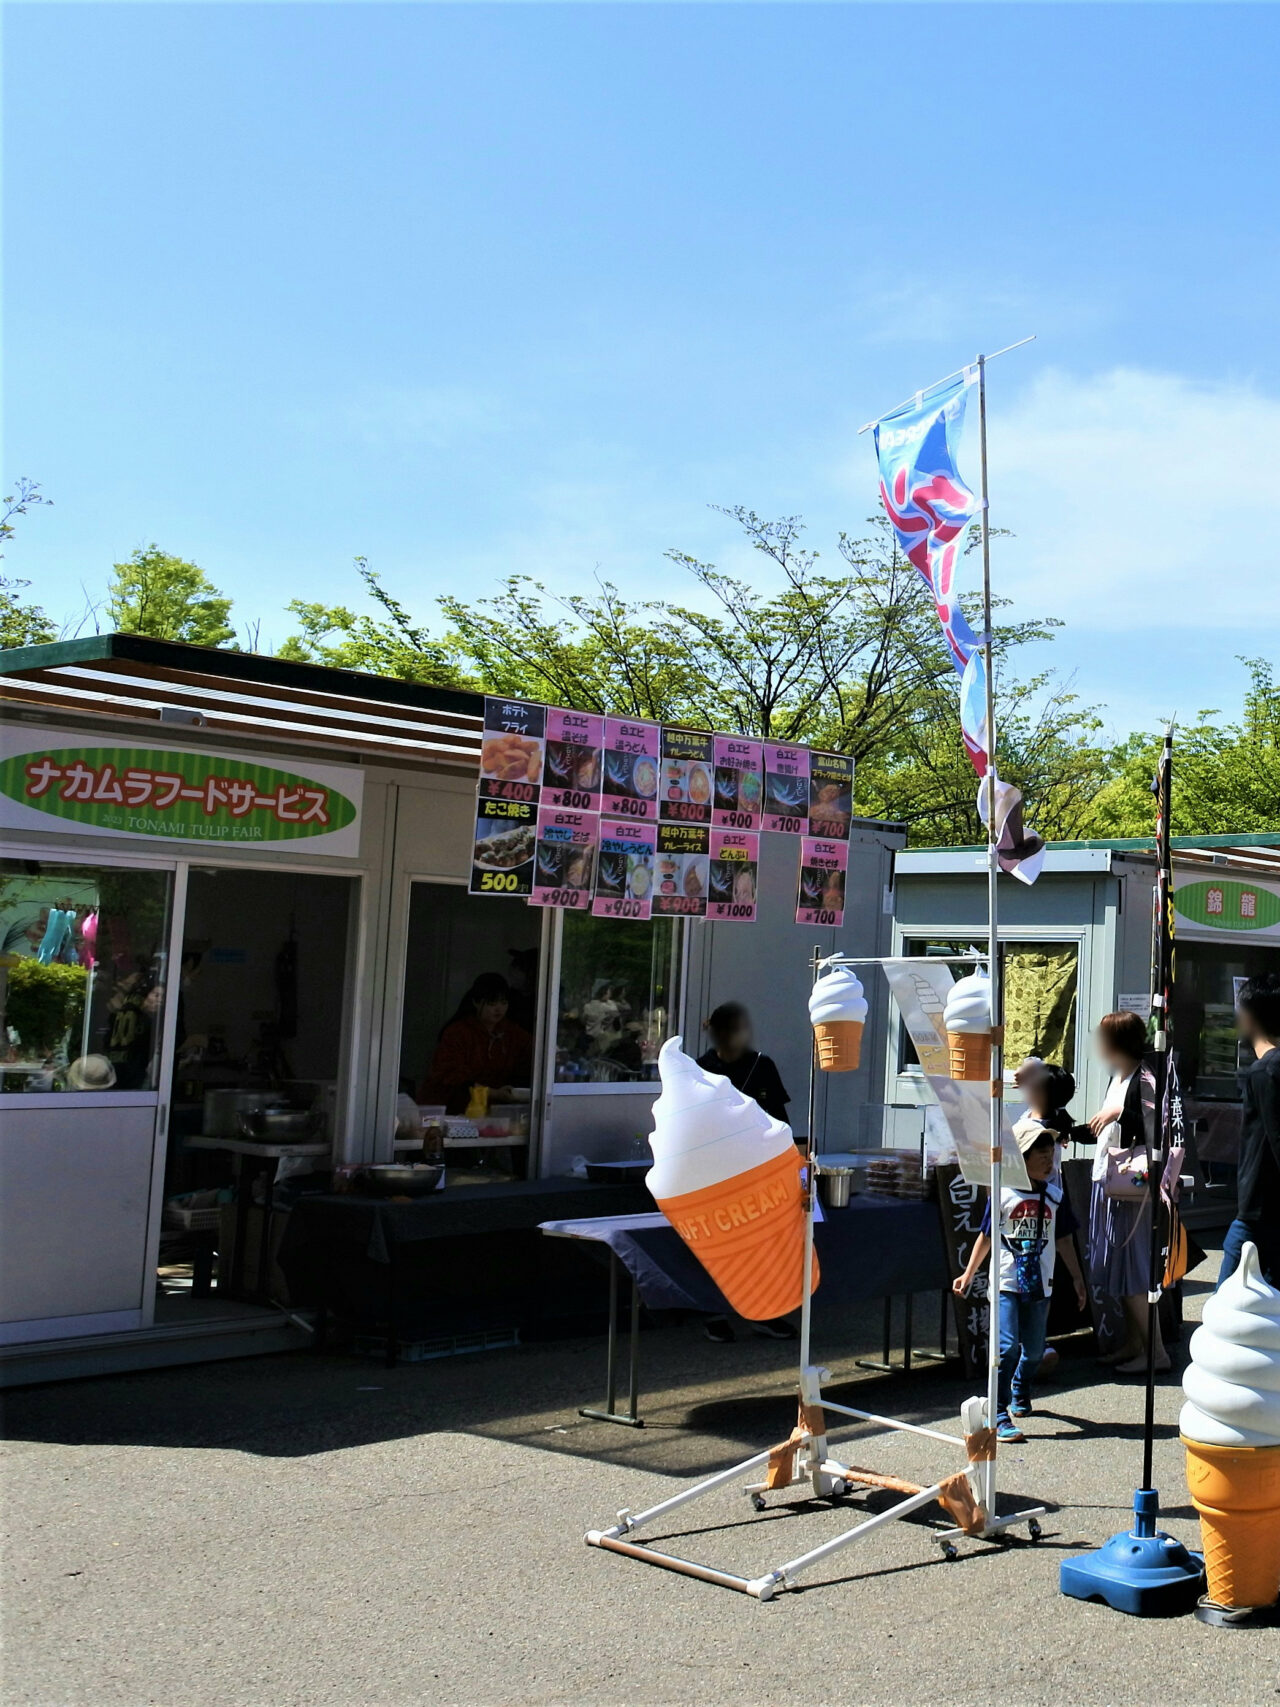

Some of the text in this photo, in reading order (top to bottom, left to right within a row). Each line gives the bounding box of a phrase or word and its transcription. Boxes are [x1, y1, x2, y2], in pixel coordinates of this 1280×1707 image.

[501, 705, 529, 718] ポテト
[501, 720, 529, 735] フライ
[562, 714, 589, 729] 白エビ
[619, 725, 646, 739] 白エビ
[727, 743, 750, 755] 白エビ
[776, 750, 798, 761] 白エビ
[26, 757, 330, 826] ナカムラフードサービス
[488, 779, 534, 801] ¥400
[552, 791, 591, 809] ¥800
[484, 801, 531, 818] たこ焼き
[612, 801, 648, 817] ¥800
[667, 803, 705, 818] ¥900
[554, 812, 583, 826] 白エビ
[721, 814, 753, 829] ¥900
[771, 816, 801, 833] ¥700
[128, 816, 185, 834] TONAMI
[190, 823, 229, 838] TULIP
[232, 825, 263, 839] FAIR
[615, 826, 642, 838] 白エビ
[663, 841, 702, 852] カレーライス
[722, 834, 746, 846] 白エビ
[814, 843, 836, 855] 白エビ
[542, 889, 579, 907] ¥900
[604, 900, 641, 917] ¥900
[716, 903, 753, 917] ¥1000
[806, 910, 835, 925] ¥700
[676, 1178, 789, 1241] OFT CREAM
[1012, 1218, 1051, 1230] DADY
